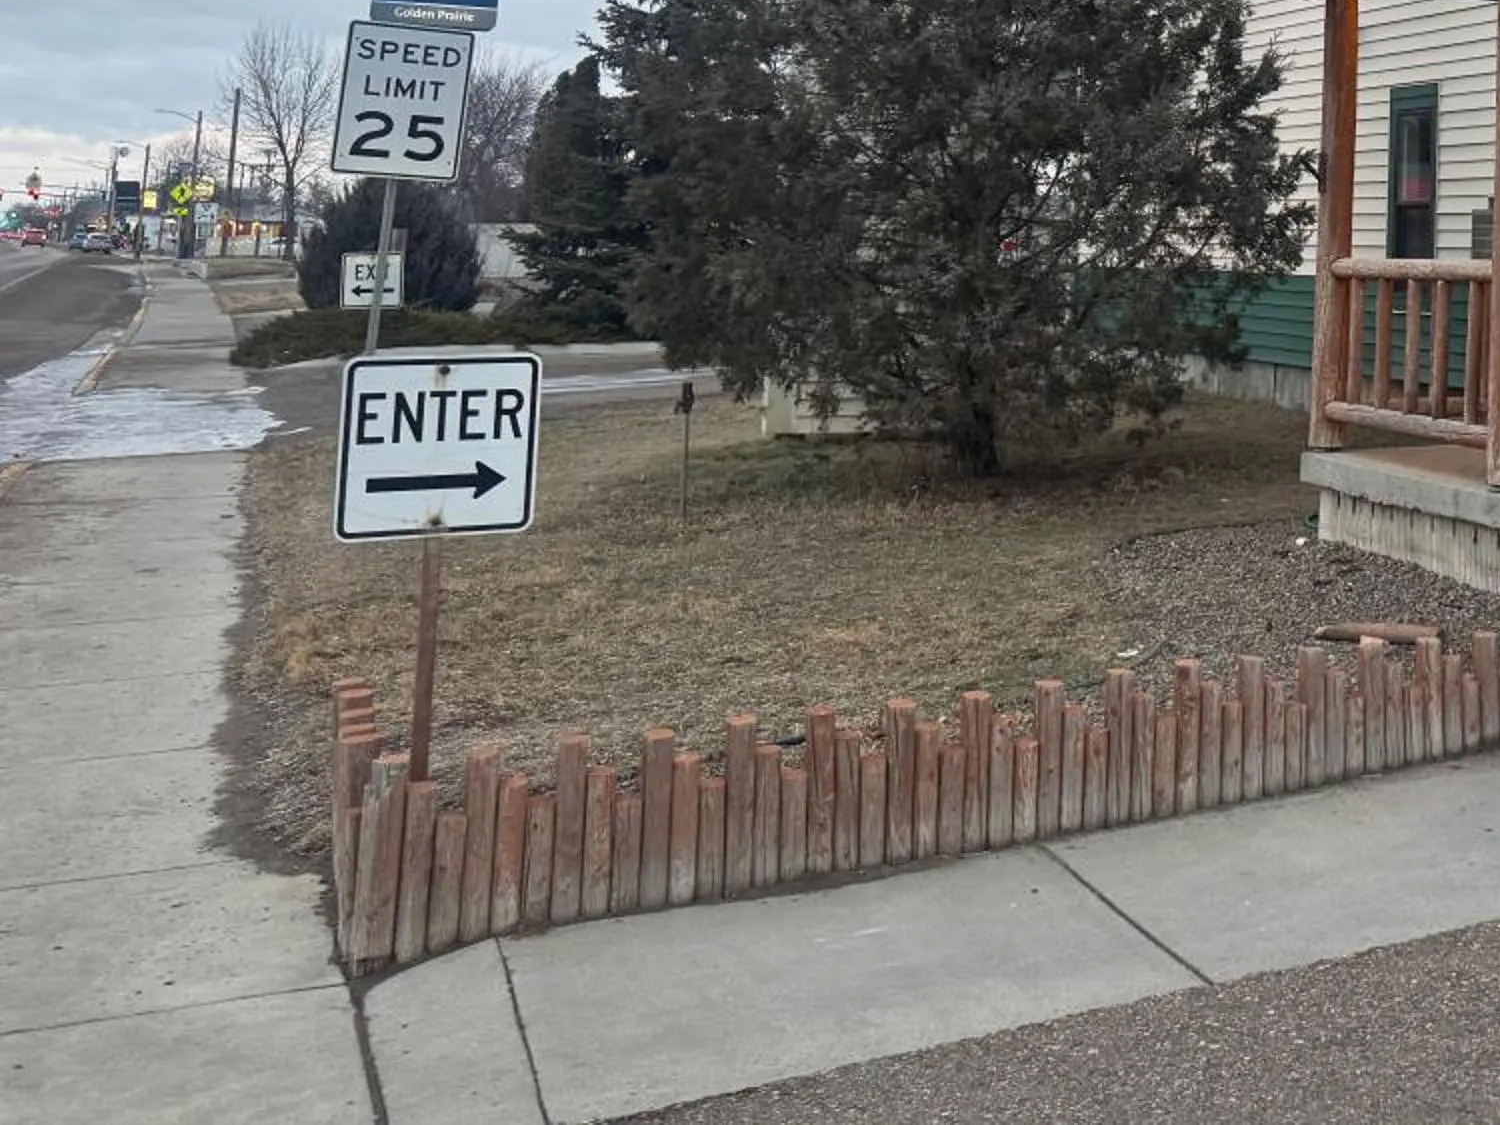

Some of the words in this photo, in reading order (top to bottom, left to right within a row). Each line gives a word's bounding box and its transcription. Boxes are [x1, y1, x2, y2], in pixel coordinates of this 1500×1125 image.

[394, 6, 435, 20] Golden
[437, 10, 475, 22] Prairie
[356, 39, 462, 68] SPEED
[364, 74, 446, 102] LIMIT
[348, 111, 446, 162] 25
[355, 263, 390, 281] EX
[355, 388, 525, 445] ENTER
